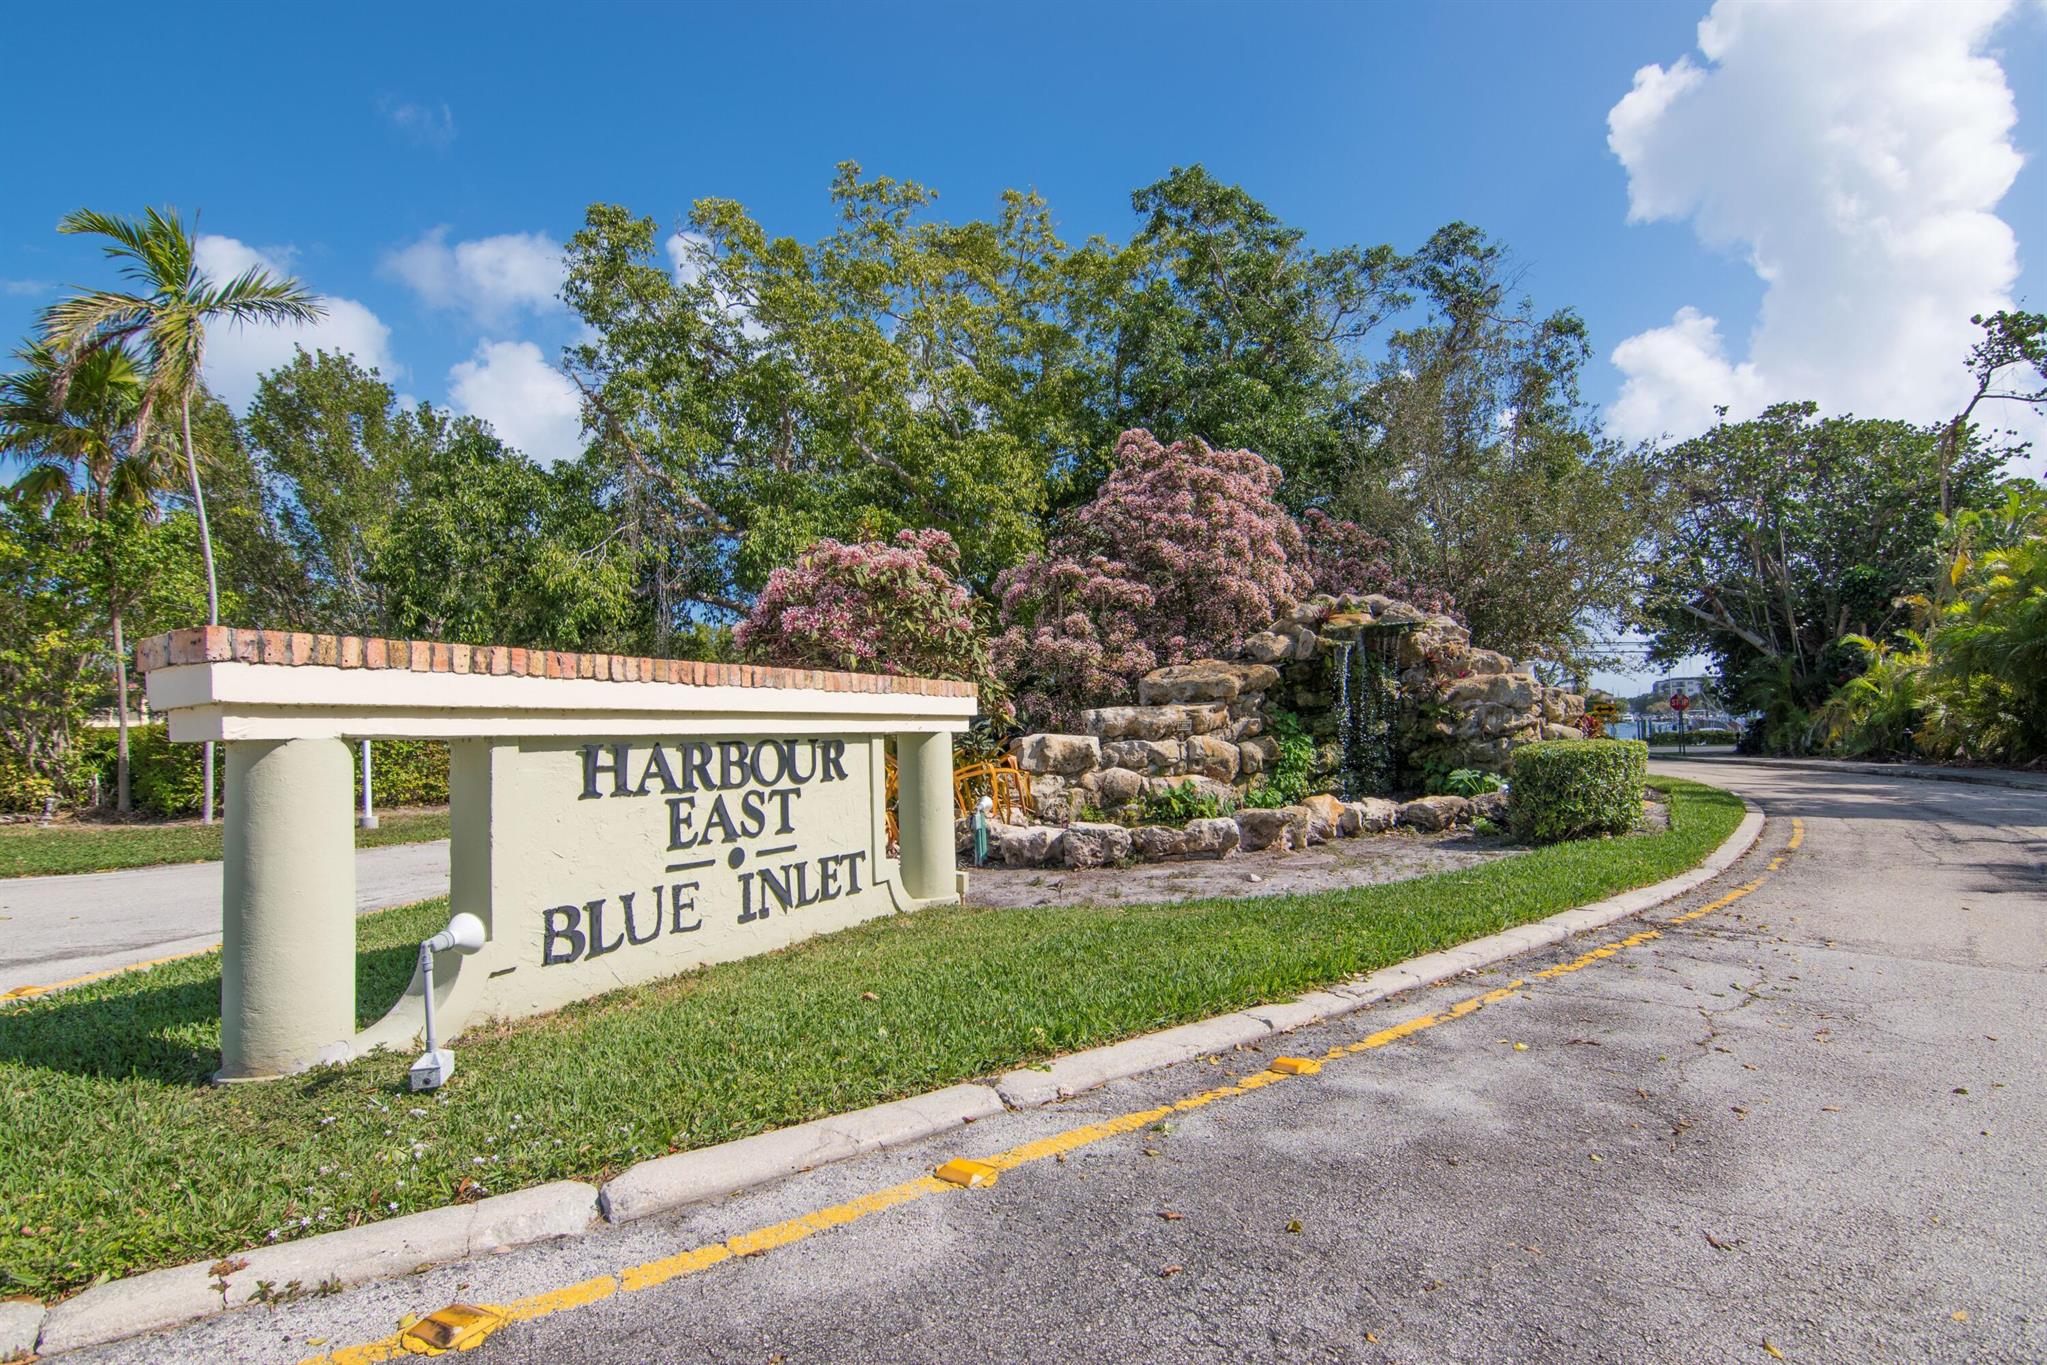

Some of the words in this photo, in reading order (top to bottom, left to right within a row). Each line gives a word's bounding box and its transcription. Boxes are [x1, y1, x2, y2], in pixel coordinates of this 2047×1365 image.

[576, 738, 848, 801] HARBOUR
[664, 787, 801, 852] EAST
[541, 881, 702, 967] BLUE
[737, 850, 866, 924] INLET
